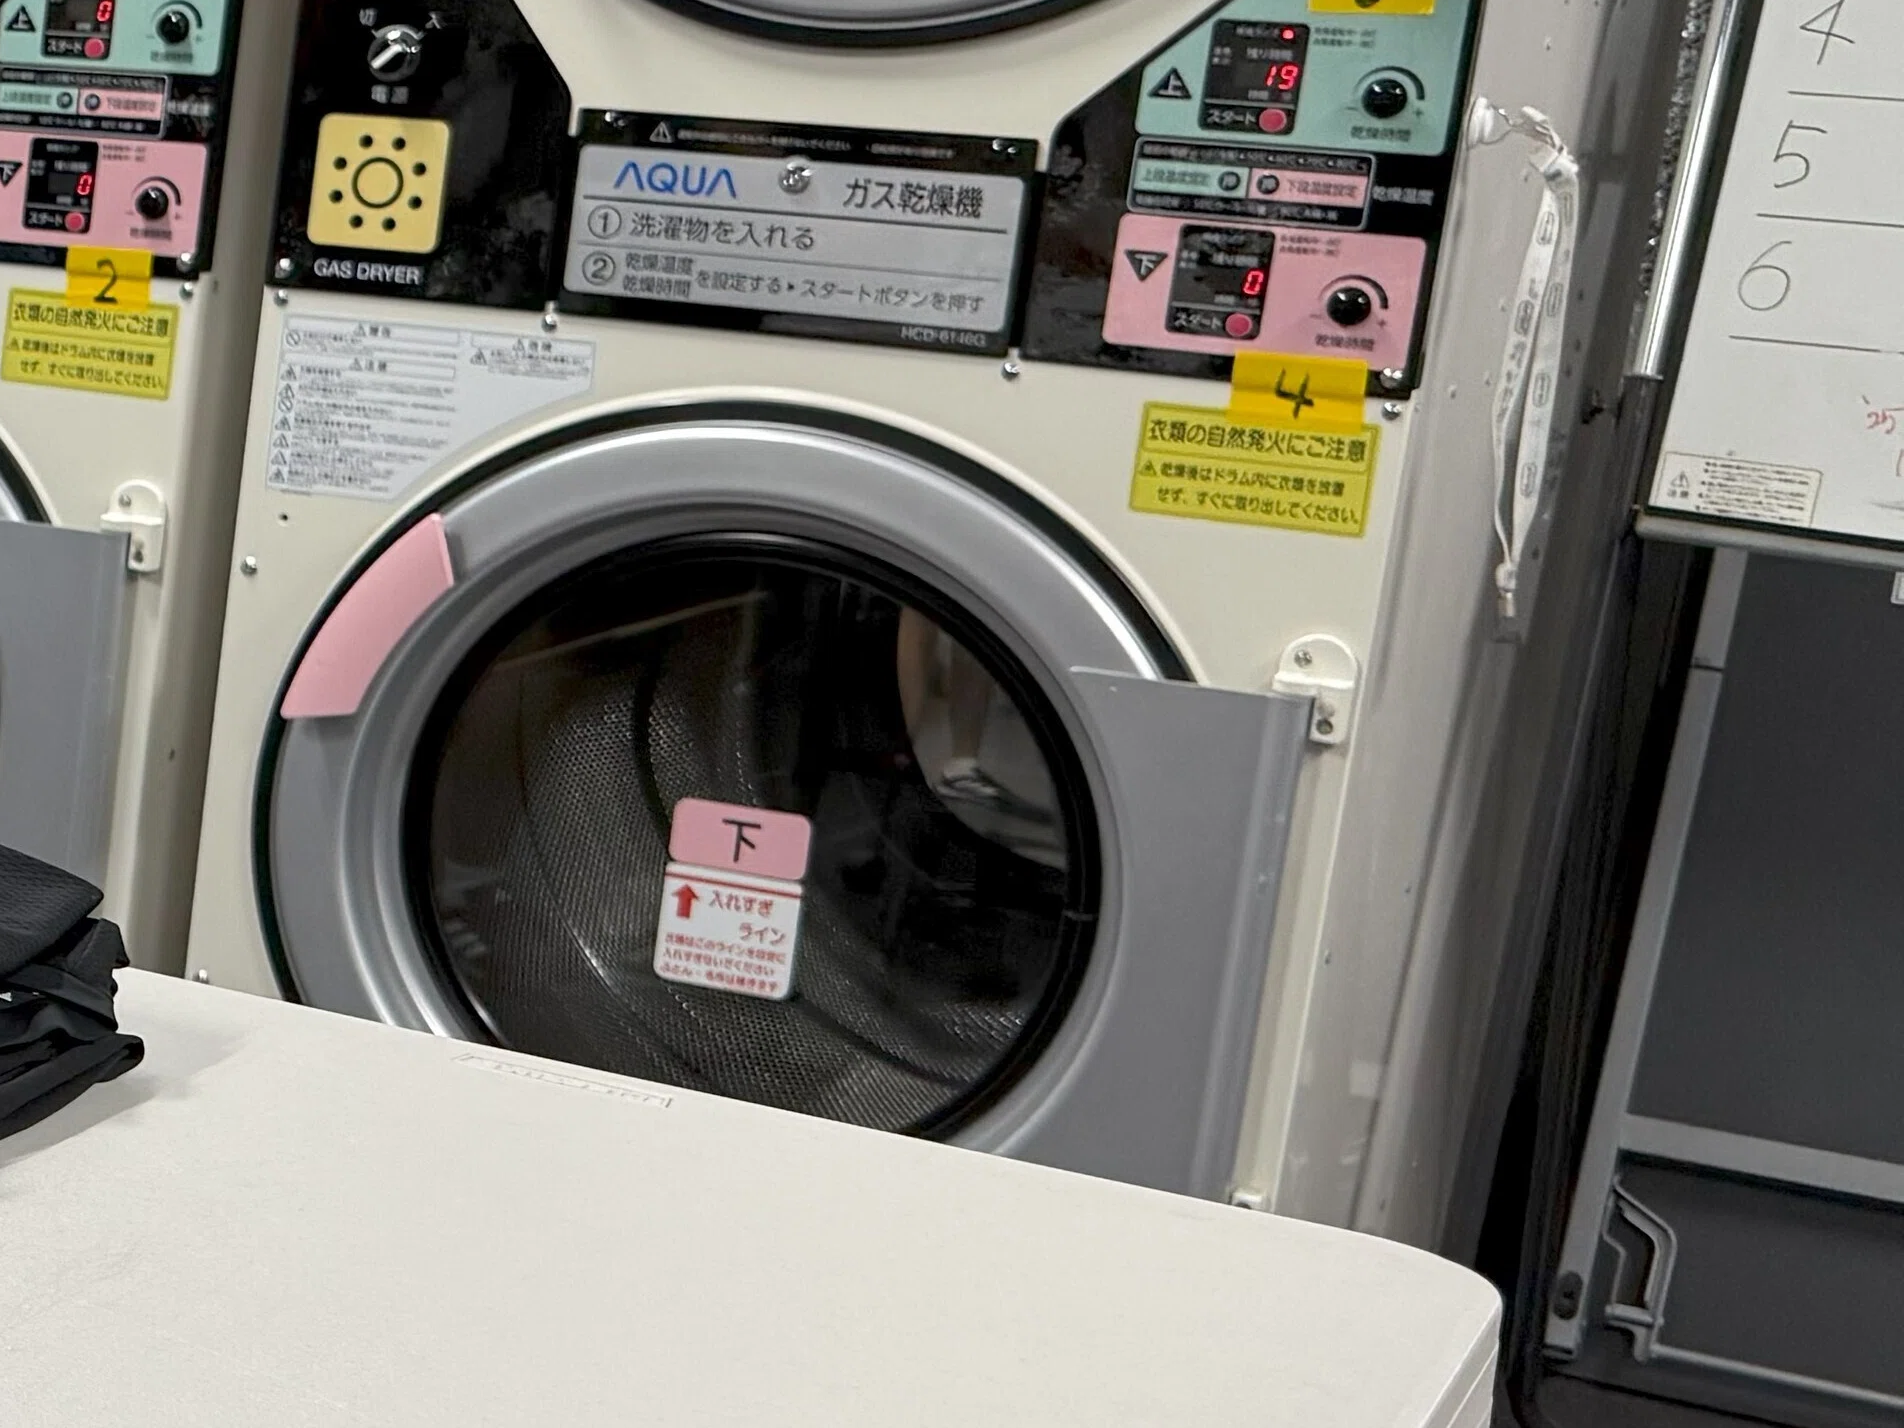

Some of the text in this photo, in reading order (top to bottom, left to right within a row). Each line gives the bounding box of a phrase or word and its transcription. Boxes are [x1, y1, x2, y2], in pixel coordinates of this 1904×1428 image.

[1265, 62, 1299, 90] 19
[1206, 109, 1257, 125] スタート
[1772, 119, 1826, 190] 5
[76, 174, 93, 196] 0
[613, 161, 986, 219] AQUA ガス乾燥機
[629, 211, 816, 251] 洗濯物を入れる
[314, 257, 421, 285] GAS DRYER
[1136, 254, 1155, 275] 下
[1737, 240, 1792, 312] 6
[94, 258, 118, 303] 2
[622, 274, 692, 299] 乾燥時間
[625, 252, 694, 275] 乾燥温度
[695, 270, 783, 294] を設定する
[800, 278, 985, 313] スタートボタンを押す
[1243, 271, 1264, 295] 0
[14, 303, 170, 338] 衣類の自然発火にご注意
[1174, 311, 1222, 330] スタート
[1274, 368, 1314, 419] 4
[1147, 419, 1366, 463] 衣類の自然発火にご注意
[722, 818, 761, 862] 下
[708, 890, 774, 918] 入れすぎ
[738, 923, 786, 945] ライン
